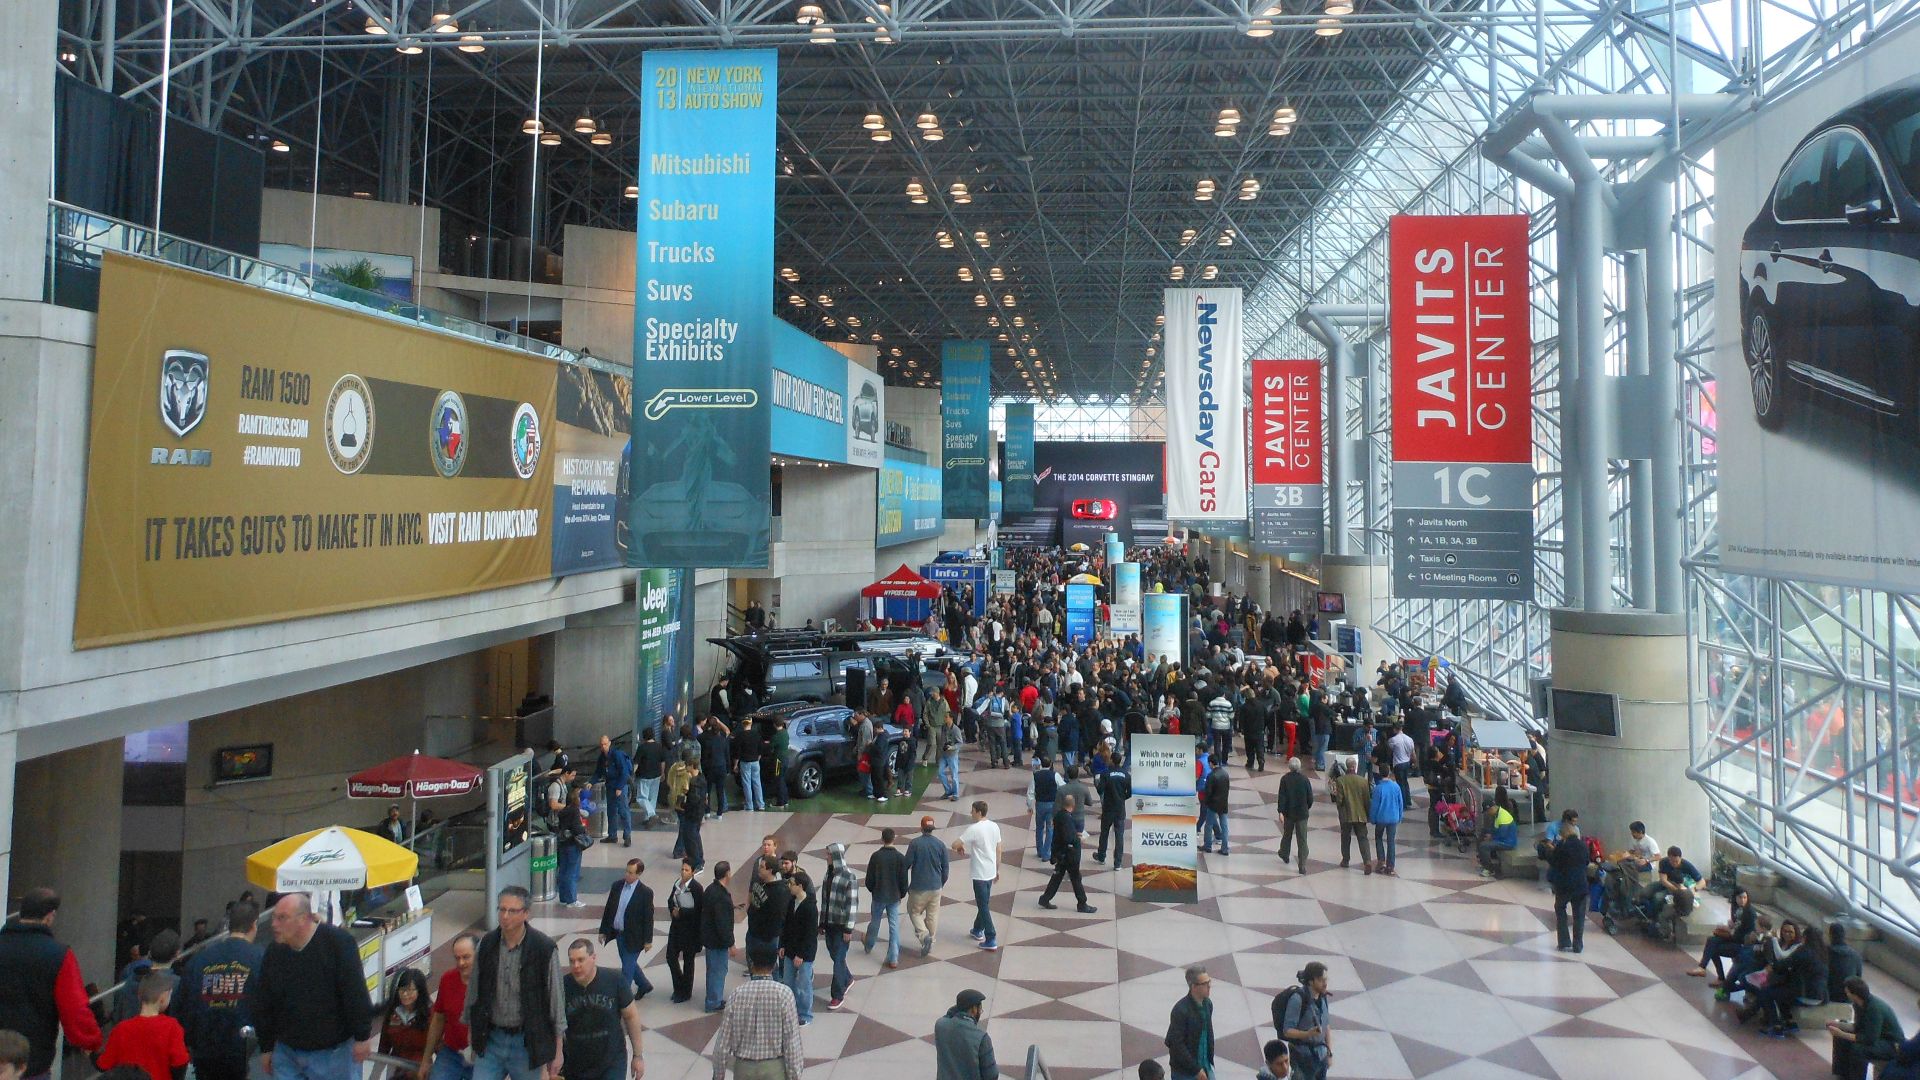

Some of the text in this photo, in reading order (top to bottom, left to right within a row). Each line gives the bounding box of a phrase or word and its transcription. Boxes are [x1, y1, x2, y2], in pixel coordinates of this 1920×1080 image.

[656, 67, 677, 88] 20
[687, 65, 763, 84] NEW YORK
[658, 91, 676, 110] 13
[685, 92, 763, 109] AUTO SHOW
[651, 152, 750, 175] Mitsubishi
[649, 199, 719, 221] Subaru
[648, 241, 715, 263] Trucks
[647, 279, 693, 301] Suvs
[646, 317, 738, 344] Specialty
[1415, 247, 1457, 429] JAVITS
[1473, 246, 1507, 431] CENTER
[646, 339, 723, 361] Exhibits
[241, 365, 310, 406] RAM 1500
[772, 368, 791, 409] WITH
[792, 376, 812, 416] ROOM
[813, 384, 825, 419] FOR
[679, 393, 747, 403] Lower Level
[945, 407, 970, 415] Trucks
[238, 413, 309, 438] RAMTRUCKS.COM
[945, 420, 962, 428] Suvs
[1264, 375, 1285, 468] JAVITS
[1293, 374, 1310, 469] CENTER
[945, 433, 978, 443] Specialty
[945, 441, 974, 449] Exhibits
[151, 447, 212, 466] RAM
[243, 445, 301, 467] #RAMNYAUTO
[563, 458, 593, 475] HISTORY
[603, 460, 615, 477] THE
[1053, 473, 1155, 482] THE 2014 CORVETTE STINGRAY
[1433, 466, 1492, 506] 1C
[1274, 486, 1303, 506] 3B
[1418, 518, 1468, 527] Javits North
[145, 517, 167, 561] IT
[174, 515, 235, 560] TAKES
[240, 514, 287, 556] GUTS
[292, 513, 313, 552] TO
[317, 513, 359, 550] MAKE
[363, 513, 377, 547] IT
[380, 513, 393, 547] IN
[397, 512, 423, 546] NYC.
[428, 512, 456, 545] VISIT
[457, 511, 481, 543] RAM
[1419, 536, 1478, 546] 1A, 1B, 3A, 3B
[1419, 554, 1441, 563] Taxis
[935, 569, 958, 577] Info
[1420, 573, 1498, 583] 1C Meeting Rooms
[642, 581, 667, 614] Jeep
[883, 589, 918, 597] NYPOST.COM
[1139, 759, 1187, 768] is right for me?
[1140, 750, 1160, 759] Which
[1160, 751, 1174, 759] new
[416, 779, 470, 793] Häagen-Dazs
[1141, 832, 1187, 840] NEW CAR
[1141, 839, 1188, 847] ADVISORS
[299, 878, 324, 886] FROZEN
[325, 877, 360, 885] LEMONADE
[201, 973, 249, 994] FDNY
